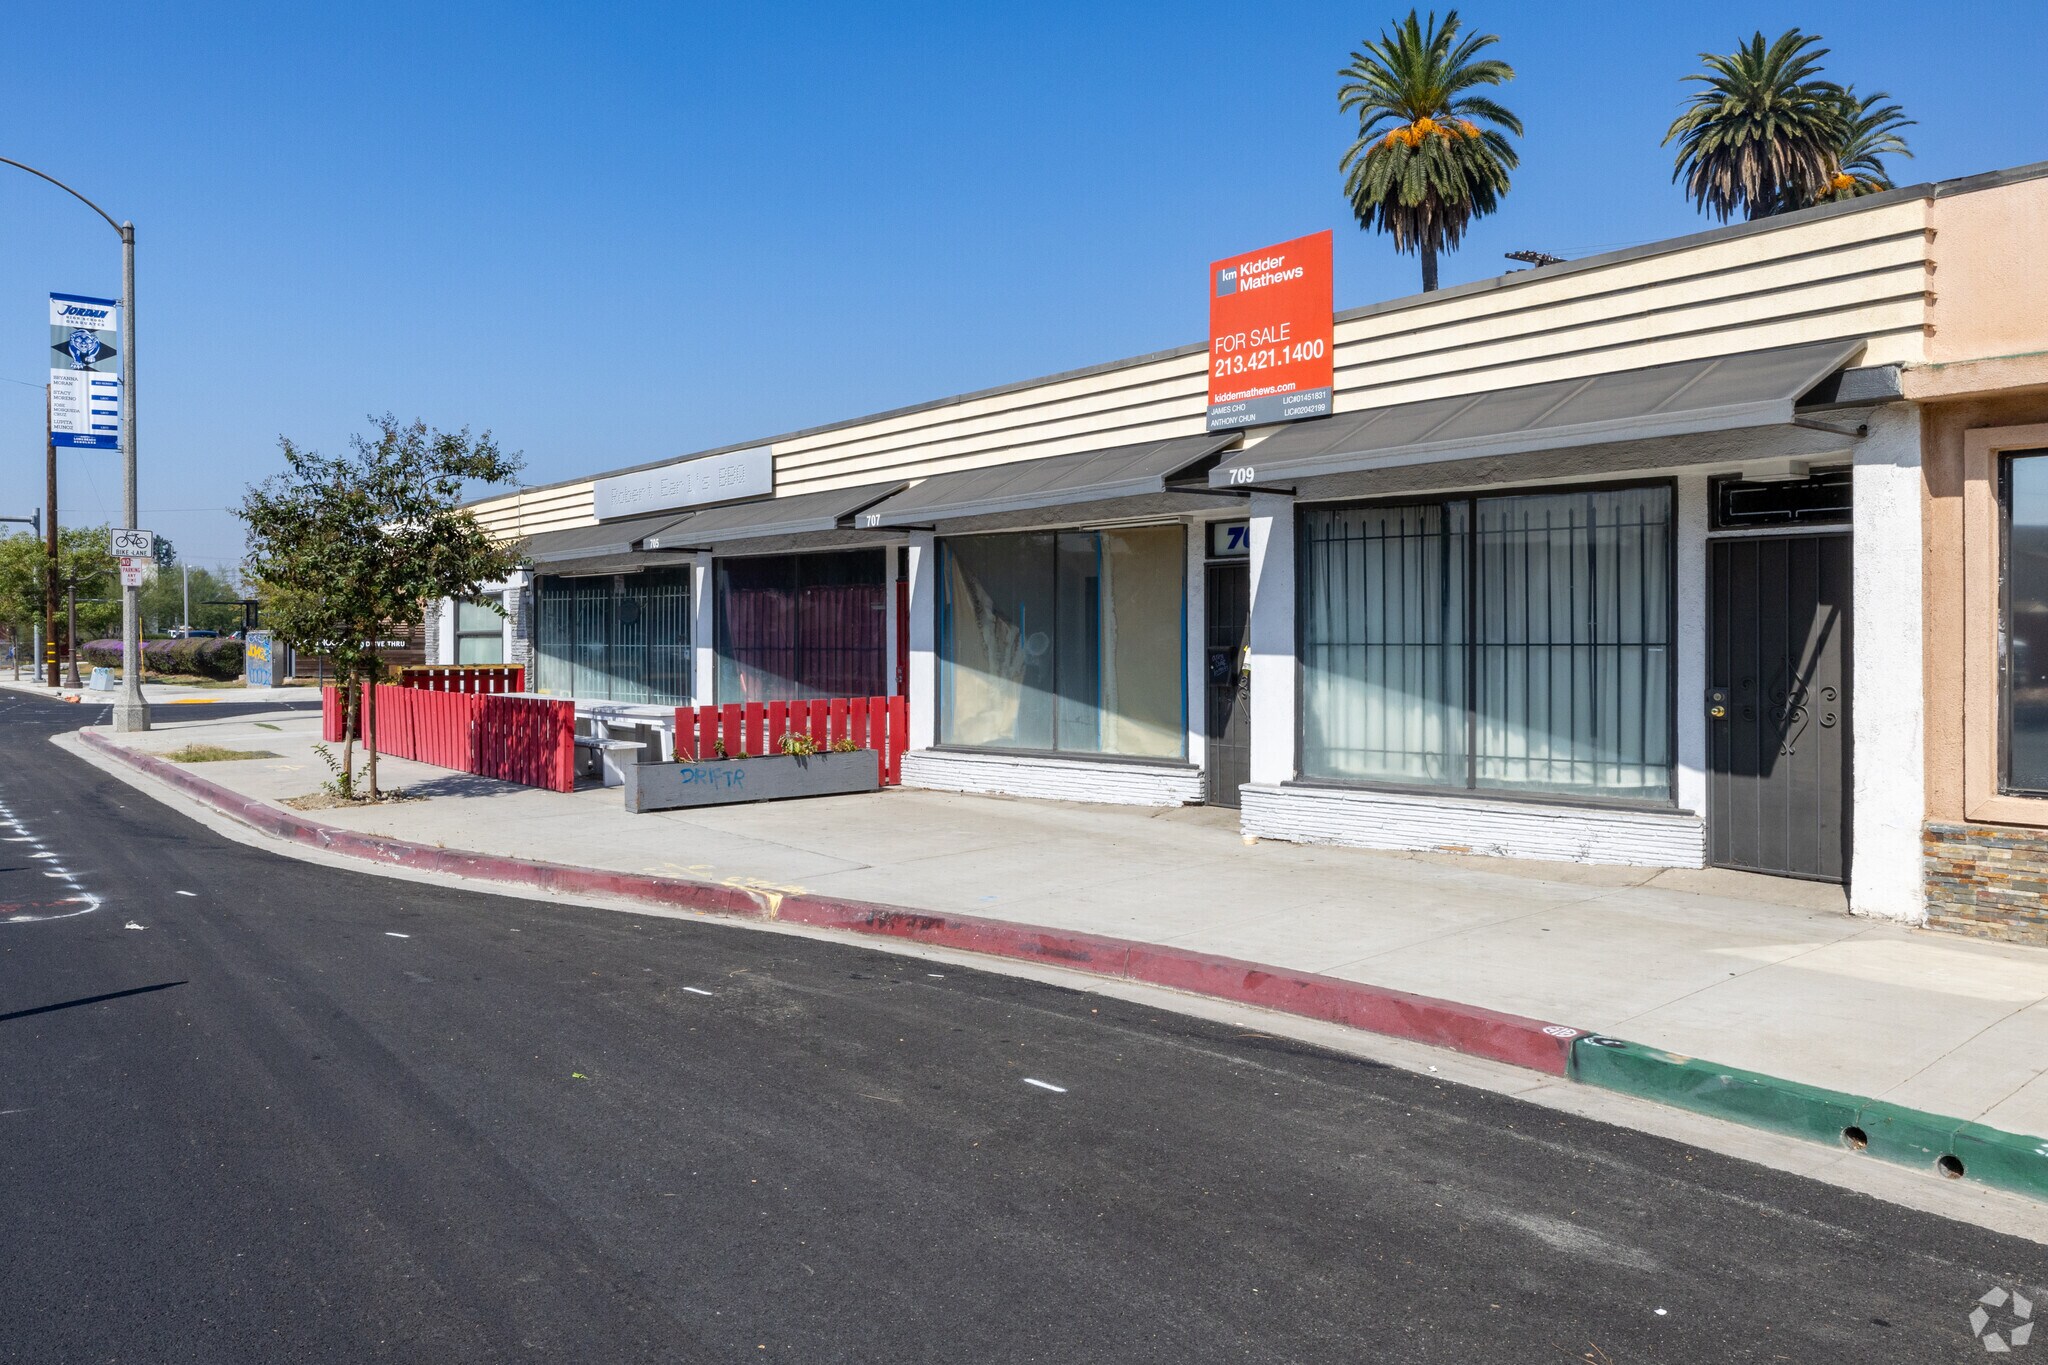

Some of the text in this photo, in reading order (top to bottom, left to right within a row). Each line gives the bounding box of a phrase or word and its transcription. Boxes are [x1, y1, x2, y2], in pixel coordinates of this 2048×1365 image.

[1240, 256, 1285, 277] Kidder
[1222, 269, 1237, 281] km
[1240, 266, 1304, 292] Mathews
[57, 304, 109, 319] JORDAN
[1215, 322, 1291, 354] FOR SALE
[1215, 338, 1324, 378] 213.421.1400
[1214, 382, 1296, 403] kiddermathews.com
[1282, 391, 1326, 405] LIC#01451831
[1211, 403, 1246, 416] JAMES CHO
[1284, 403, 1326, 416] LIC#02042199
[1210, 413, 1256, 427] ANTHONY CHUN
[1229, 467, 1255, 485] 709
[611, 464, 746, 505] Robert Earl's BBQ
[866, 514, 881, 527] 707
[650, 538, 660, 549] 705
